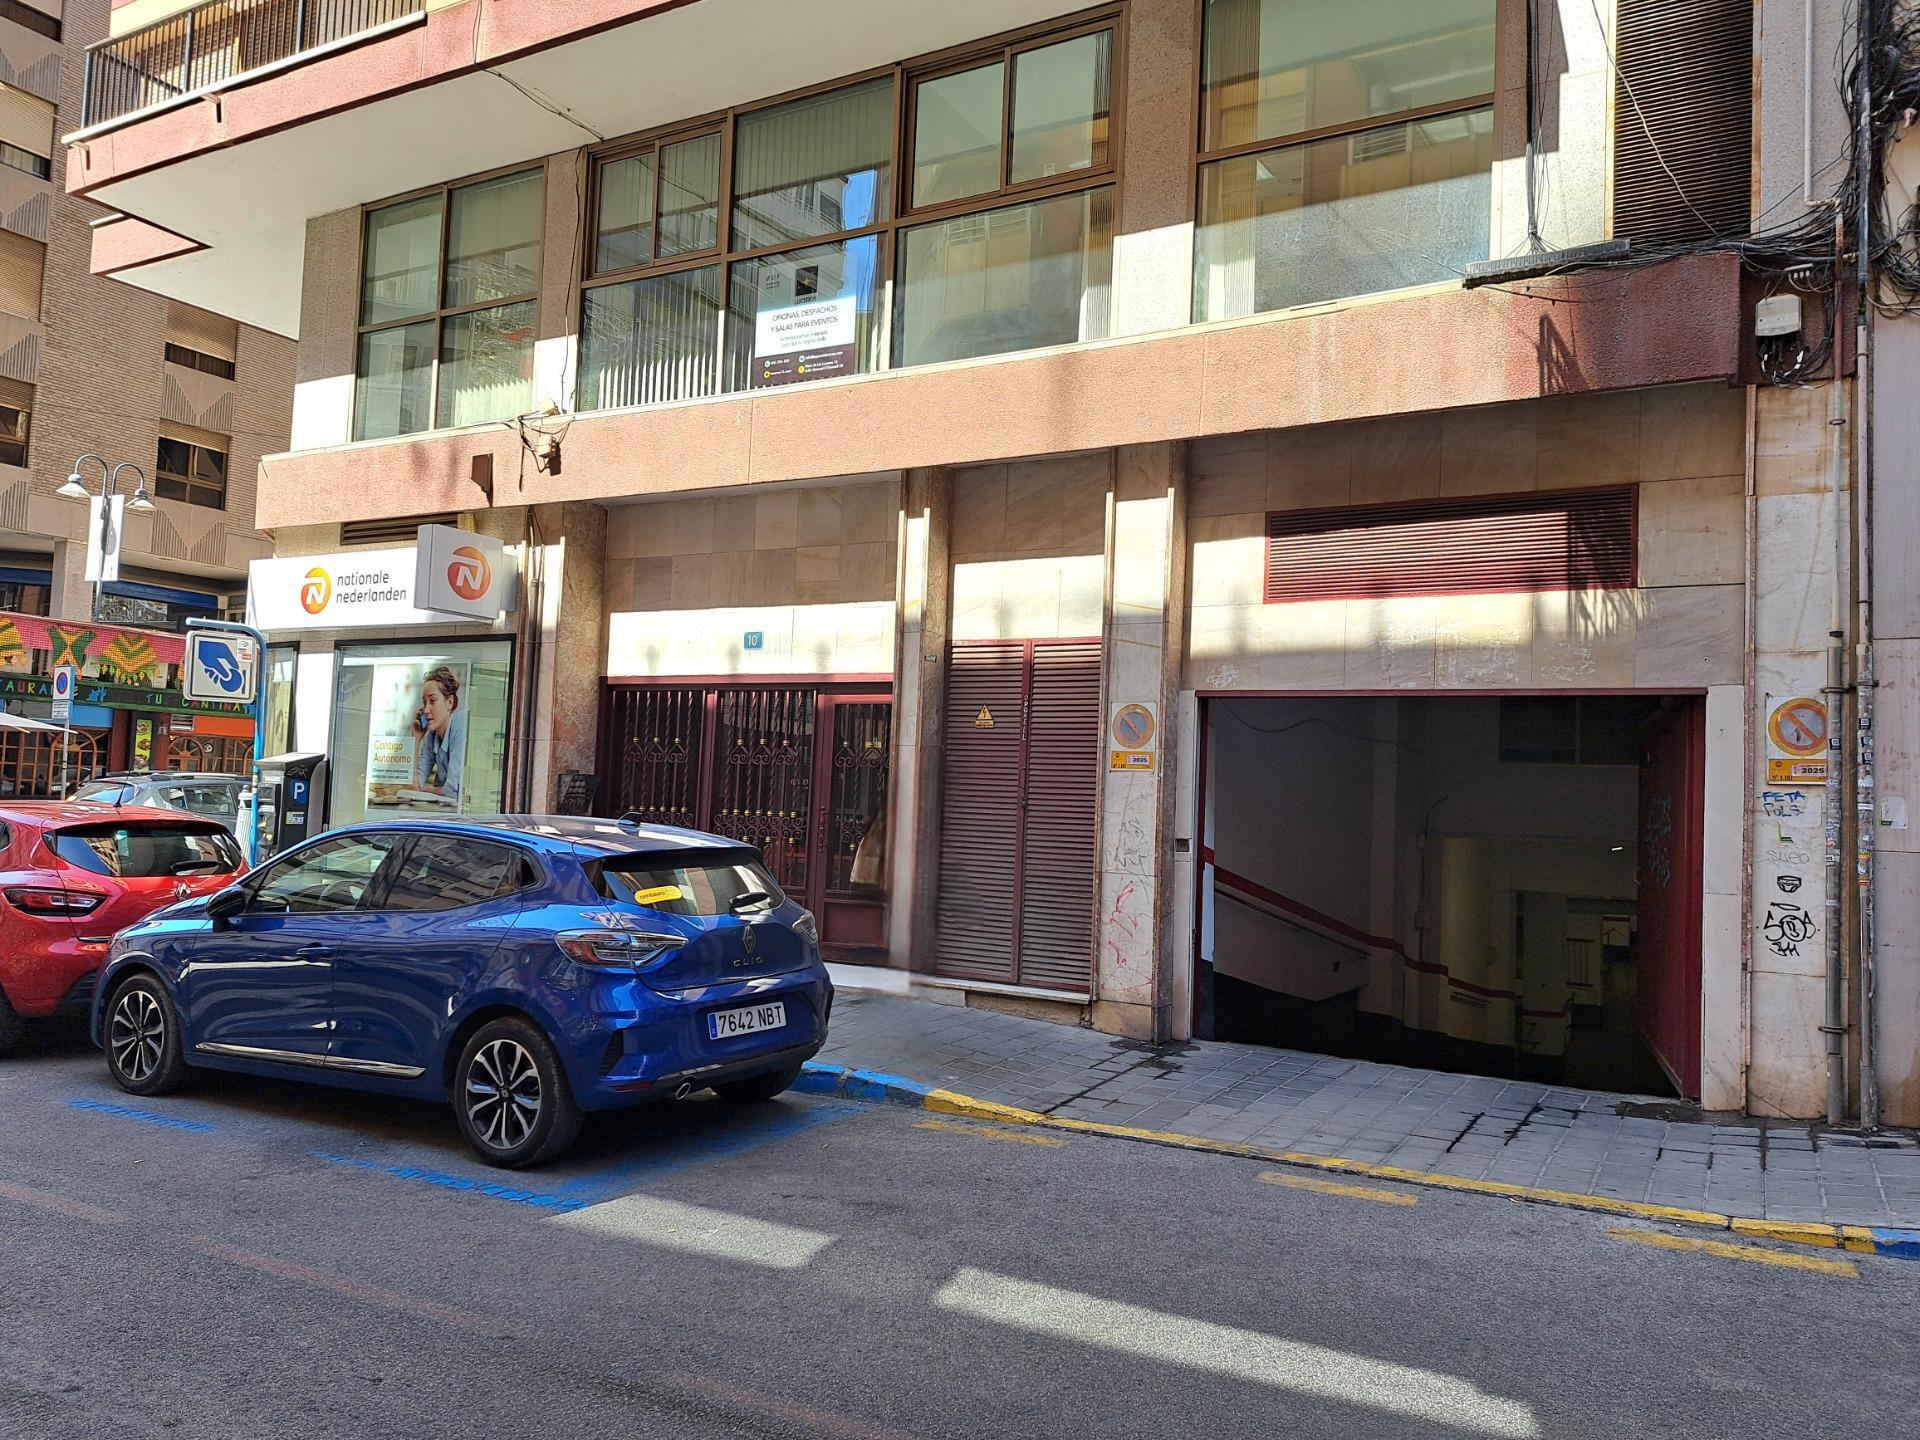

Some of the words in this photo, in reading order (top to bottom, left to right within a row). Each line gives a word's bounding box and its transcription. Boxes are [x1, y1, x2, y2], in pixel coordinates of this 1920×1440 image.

[776, 322, 794, 332] SALAS
[794, 320, 810, 329] PARA
[811, 316, 839, 327] EVENTOS
[337, 570, 389, 587] nationale
[336, 586, 407, 603] nederlanden
[146, 693, 163, 704] TU
[374, 741, 403, 752] Contigo
[293, 782, 305, 800] P
[733, 956, 764, 967] CLIO
[718, 1010, 755, 1035] 7642
[757, 1005, 782, 1028] NBT
